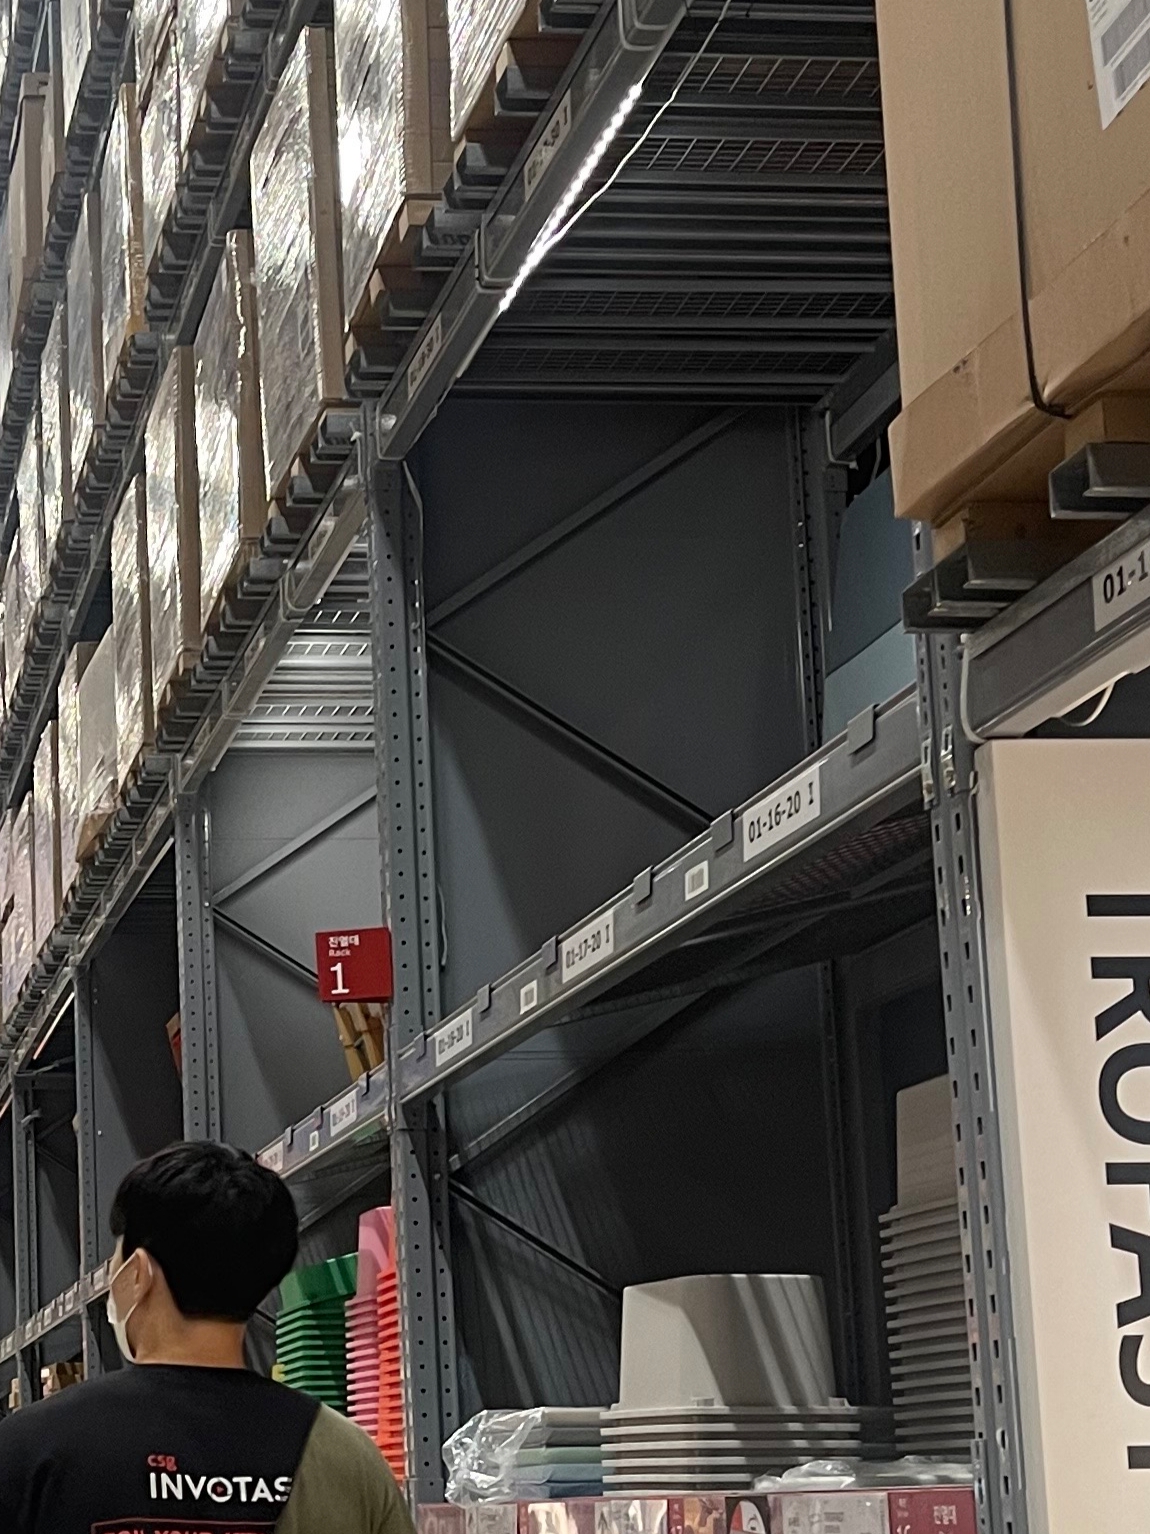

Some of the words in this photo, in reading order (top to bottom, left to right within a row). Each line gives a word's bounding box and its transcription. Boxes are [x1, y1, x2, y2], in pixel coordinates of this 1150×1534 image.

[748, 789, 802, 844] 01-16-20
[330, 962, 350, 995] 1
[149, 1472, 293, 1503] INVOTAS
